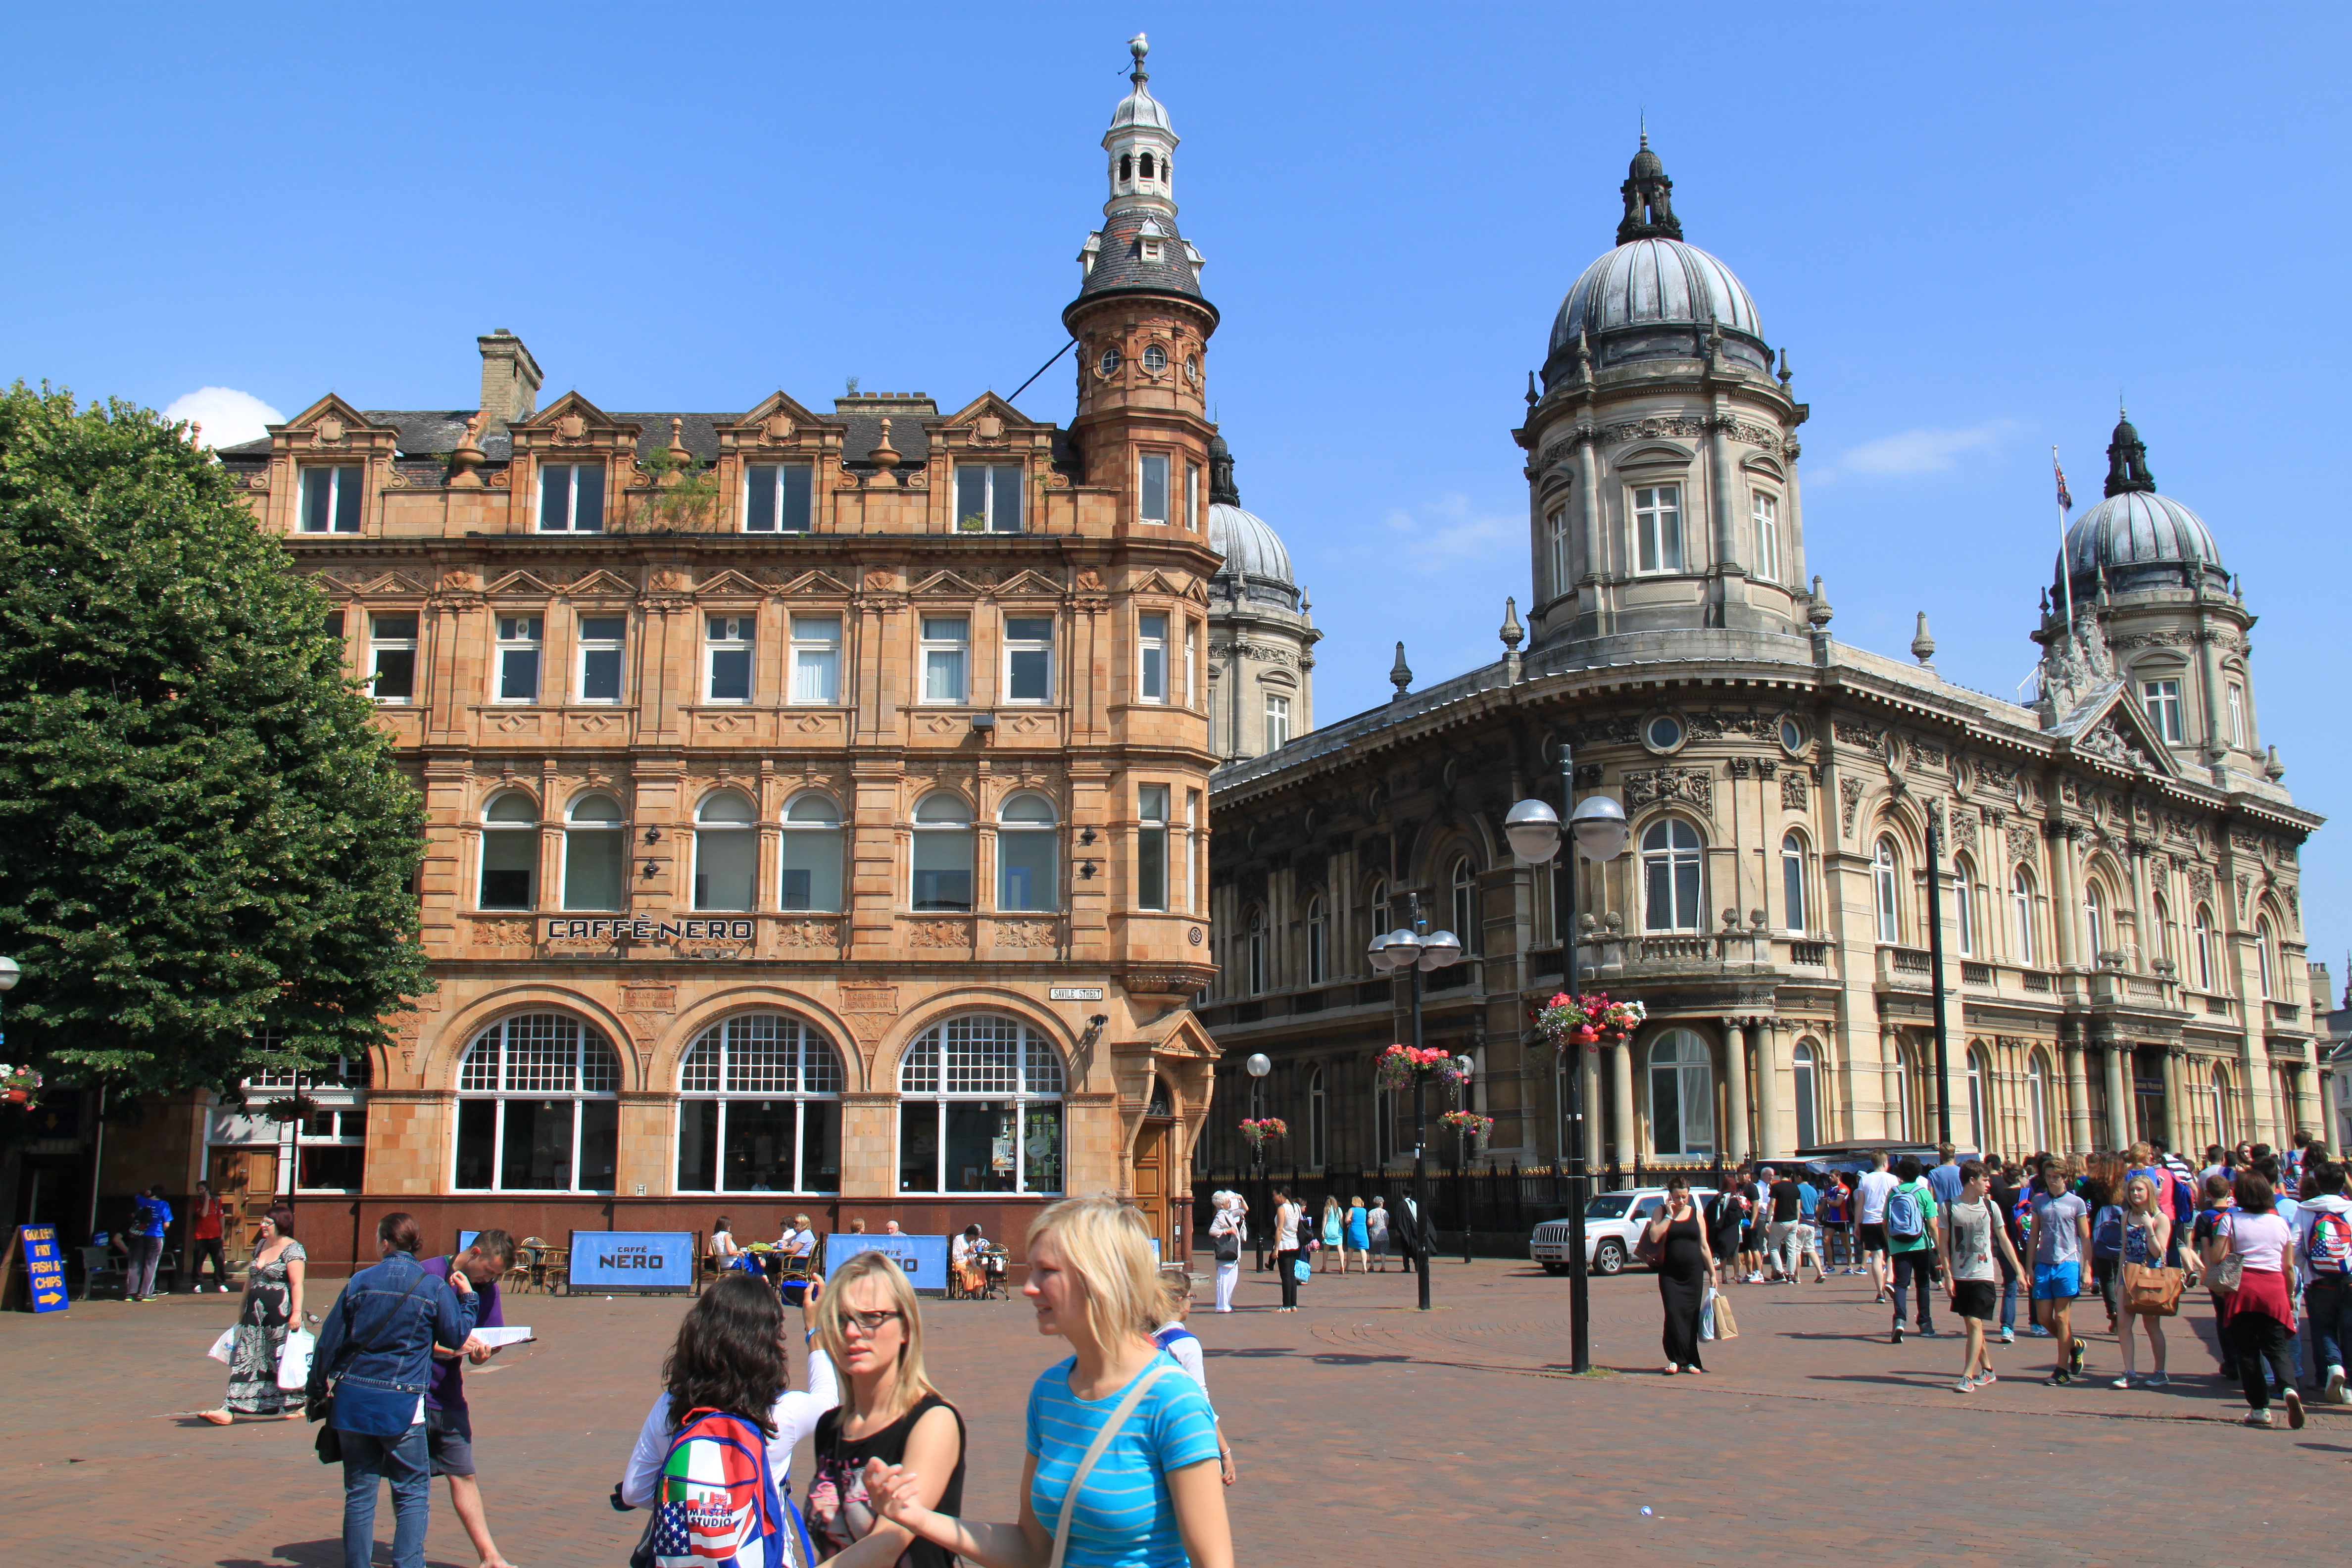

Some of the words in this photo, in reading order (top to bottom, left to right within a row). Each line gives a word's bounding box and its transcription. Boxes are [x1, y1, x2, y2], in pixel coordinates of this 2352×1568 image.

[548, 912, 652, 939] CAFFÈ
[659, 920, 753, 939] NERO
[1054, 989, 1075, 998] SAVILE
[1079, 989, 1100, 998] STREET
[24, 1228, 55, 1241] GOLDEN
[35, 1244, 51, 1257] FRY
[30, 1261, 53, 1274] FISH
[53, 1260, 61, 1272] &
[599, 1254, 663, 1269] NERO
[35, 1275, 62, 1289] CHIPS
[689, 1508, 733, 1517] MASTER
[691, 1517, 732, 1527] STUDIO
